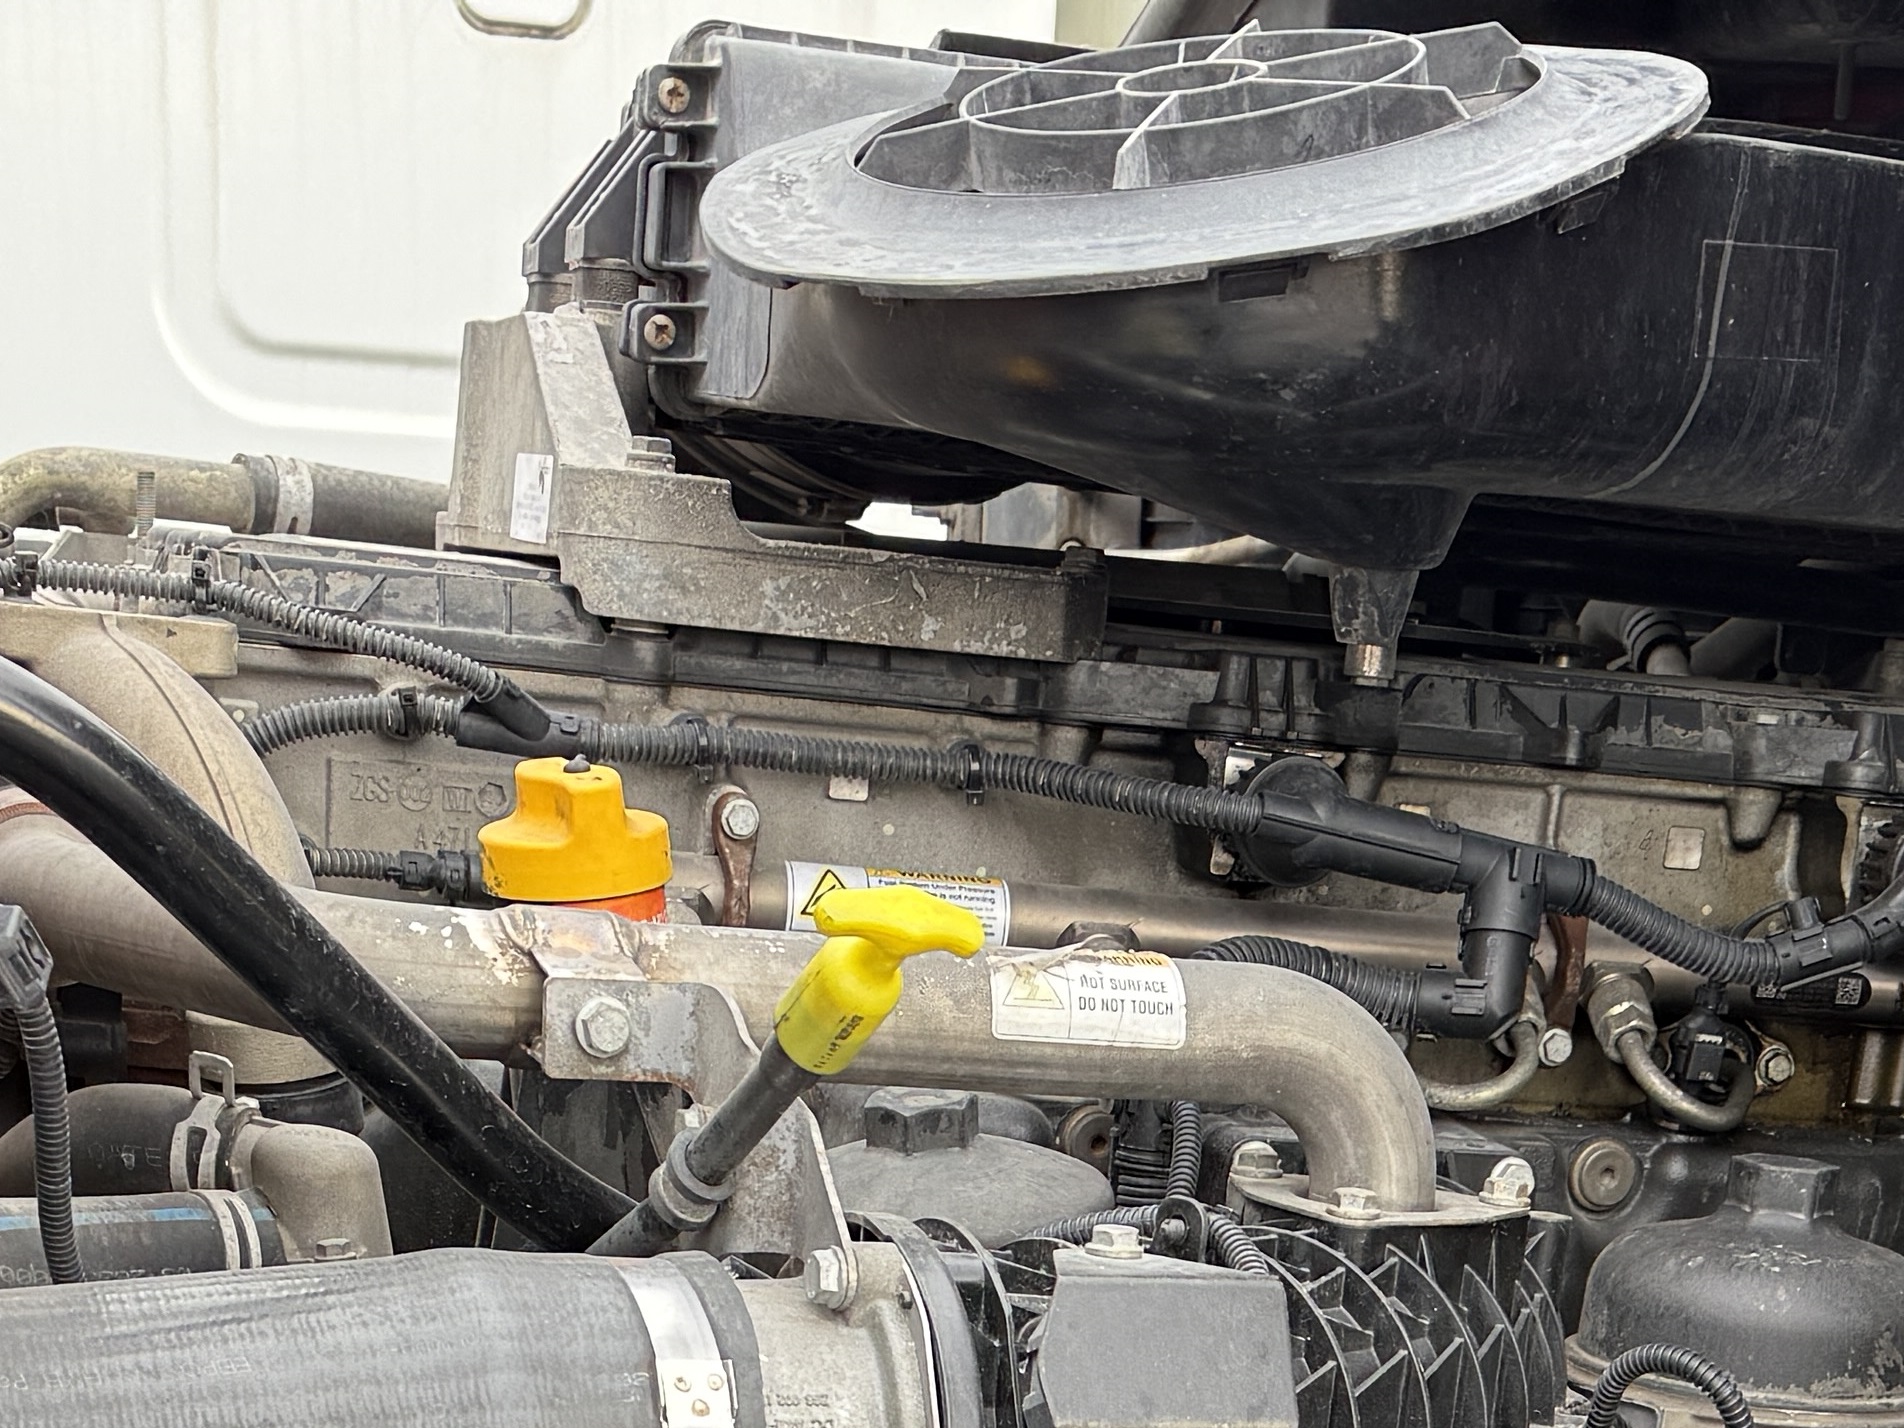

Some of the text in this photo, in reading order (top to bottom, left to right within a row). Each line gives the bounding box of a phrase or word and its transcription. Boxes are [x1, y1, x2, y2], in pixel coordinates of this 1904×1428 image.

[1110, 977, 1169, 994] SURFACE
[1078, 996, 1174, 1016] DO NOT TOUCH
